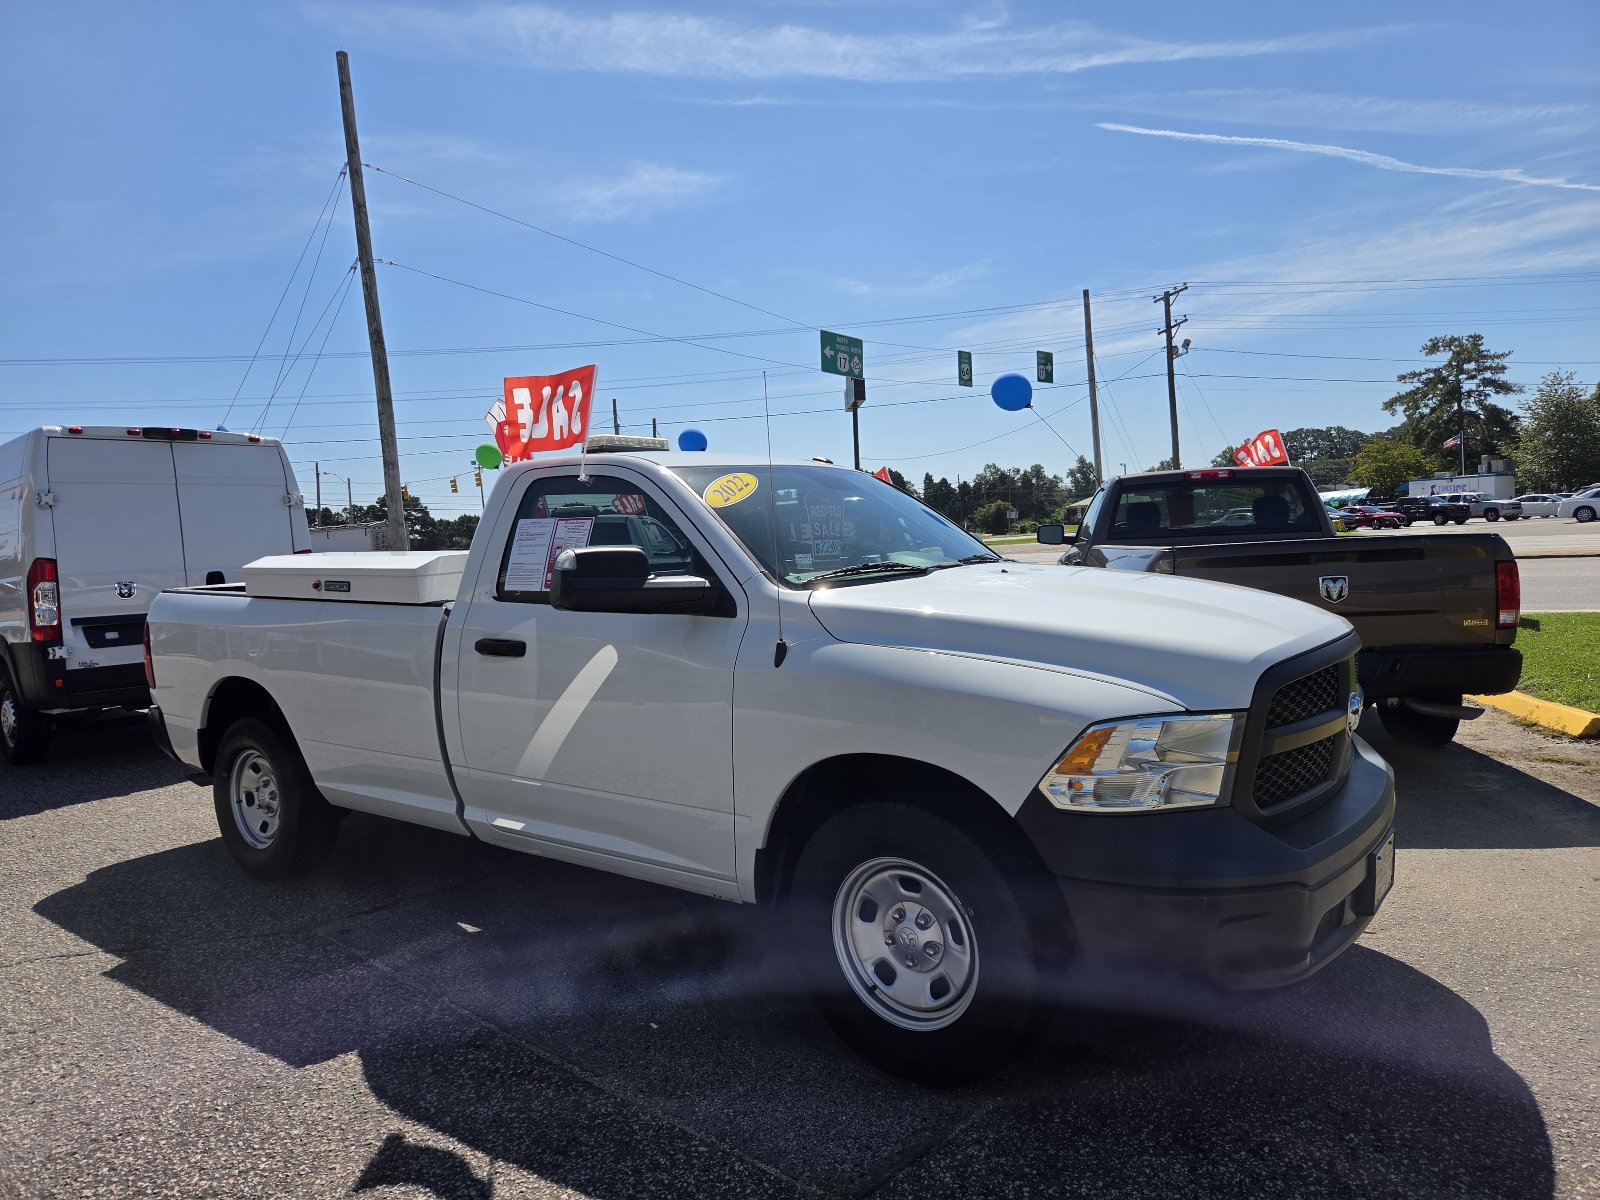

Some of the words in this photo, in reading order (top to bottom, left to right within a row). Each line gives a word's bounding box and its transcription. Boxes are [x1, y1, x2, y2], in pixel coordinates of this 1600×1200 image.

[839, 356, 848, 369] 17
[713, 475, 751, 503] 2022
[810, 505, 827, 518] RED
[828, 505, 842, 518] TAG
[813, 521, 841, 538] SALE
